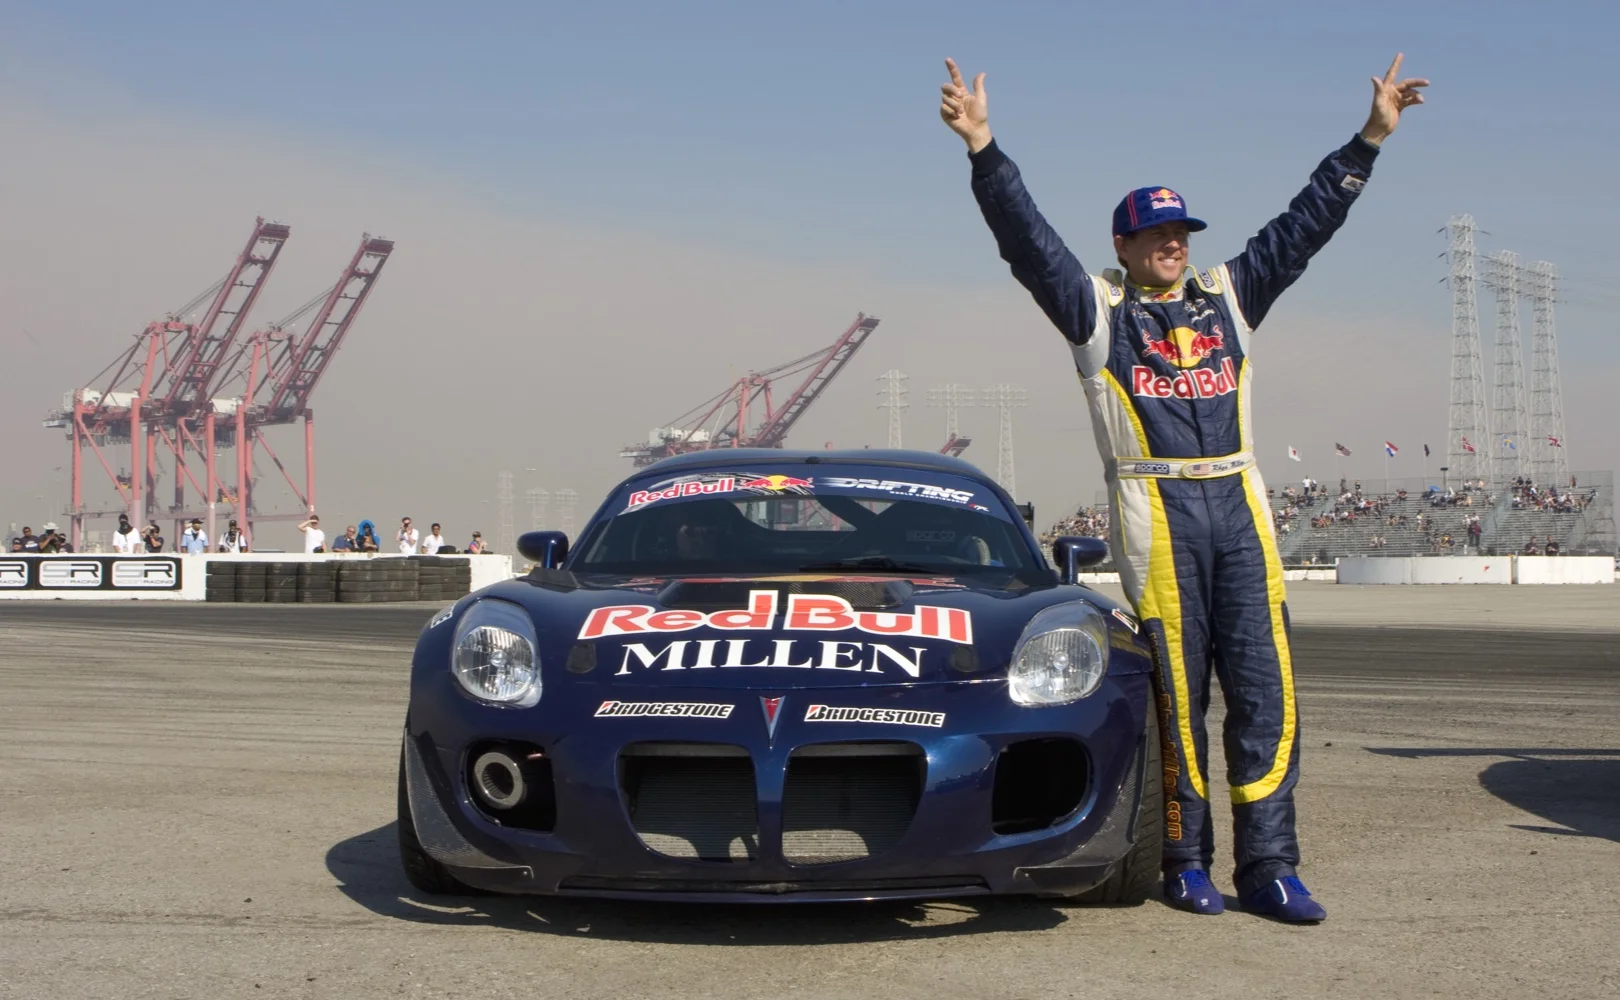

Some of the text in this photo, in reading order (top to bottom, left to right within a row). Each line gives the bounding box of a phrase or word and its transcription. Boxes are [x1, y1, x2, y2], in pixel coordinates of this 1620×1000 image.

[1132, 356, 1237, 399] Red Bull
[628, 478, 735, 508] Red Bull
[830, 477, 974, 501] DRIFTING
[42, 563, 99, 578] SR
[115, 563, 172, 578] SR
[577, 590, 974, 645] Red Bull
[614, 639, 928, 677] MILLEN
[594, 701, 735, 719] BRIDGESTONE
[804, 704, 946, 728] BRIDGESTONE
